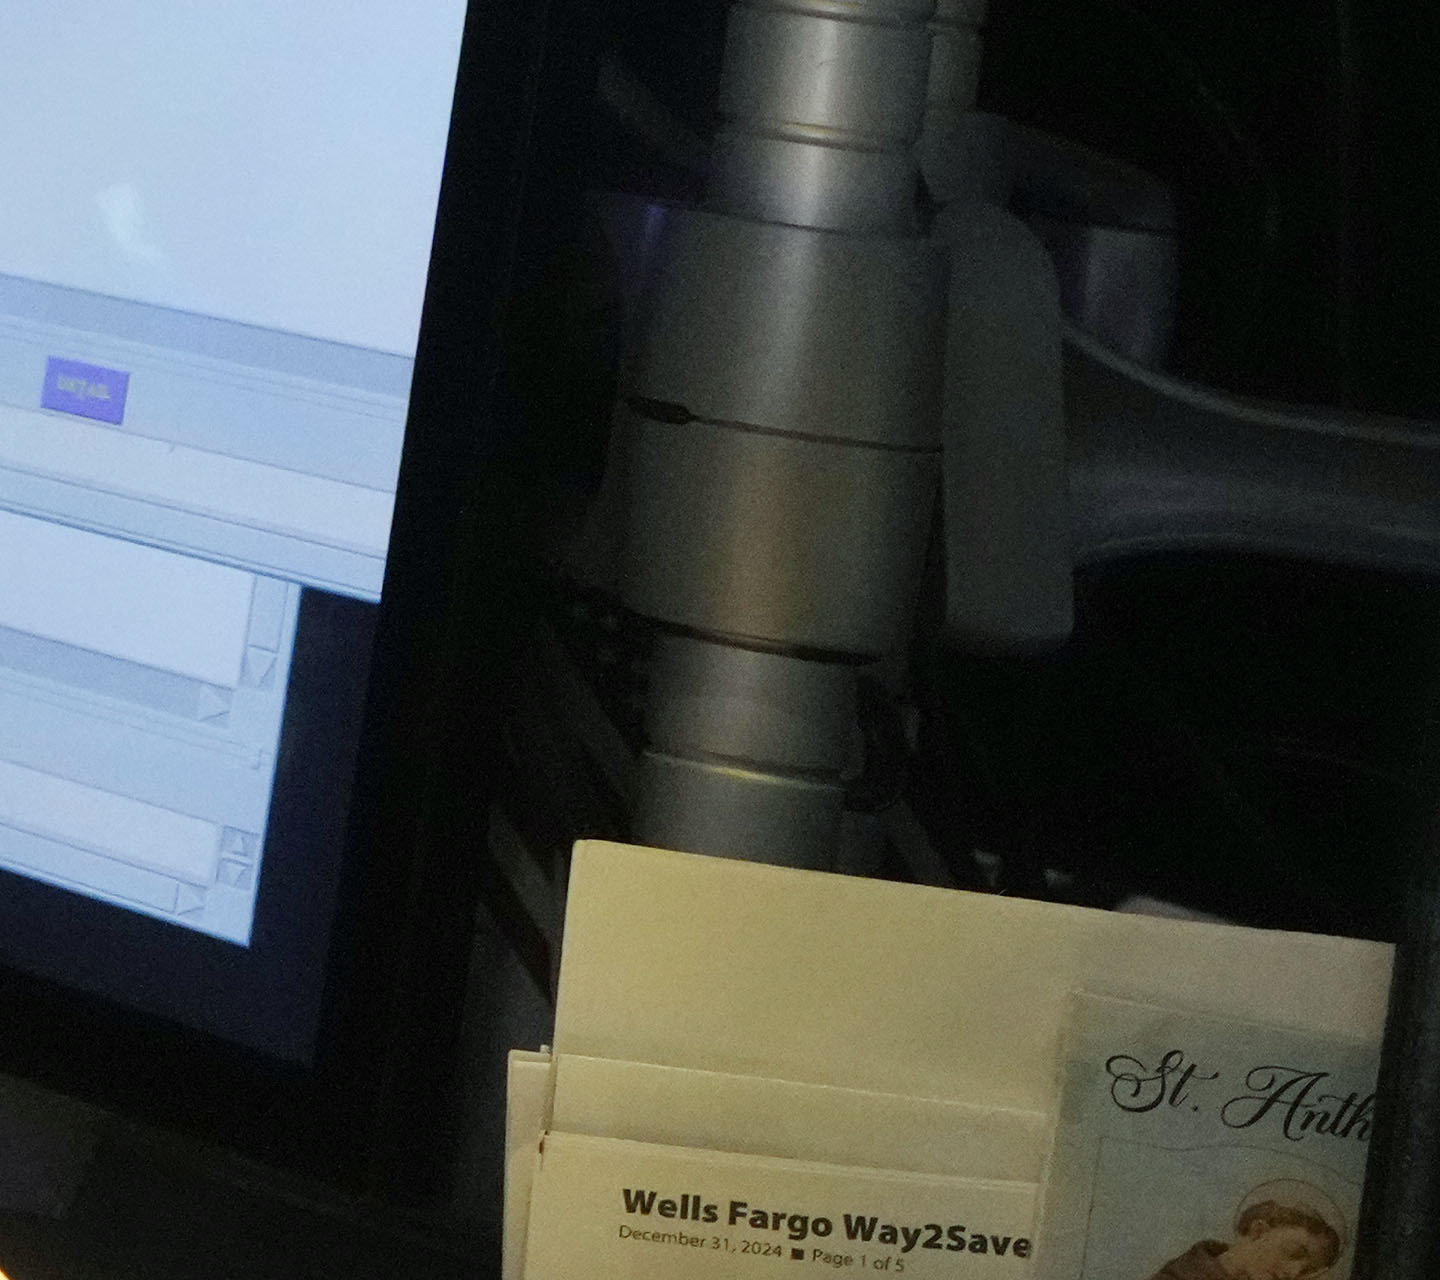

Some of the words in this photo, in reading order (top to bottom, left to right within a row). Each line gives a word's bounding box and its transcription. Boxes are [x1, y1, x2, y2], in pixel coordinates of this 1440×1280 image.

[1105, 1049, 1219, 1114] St.
[618, 1224, 706, 1250] December
[712, 1236, 737, 1255] 31,
[741, 1240, 784, 1258] 2024
[812, 1249, 854, 1269] Page
[860, 1254, 867, 1268] 1
[873, 1255, 893, 1271] of
[895, 1258, 905, 1273] 5
[622, 1188, 719, 1224] Wells
[728, 1200, 834, 1240] Fargo
[843, 1213, 1033, 1259] Way2Save
